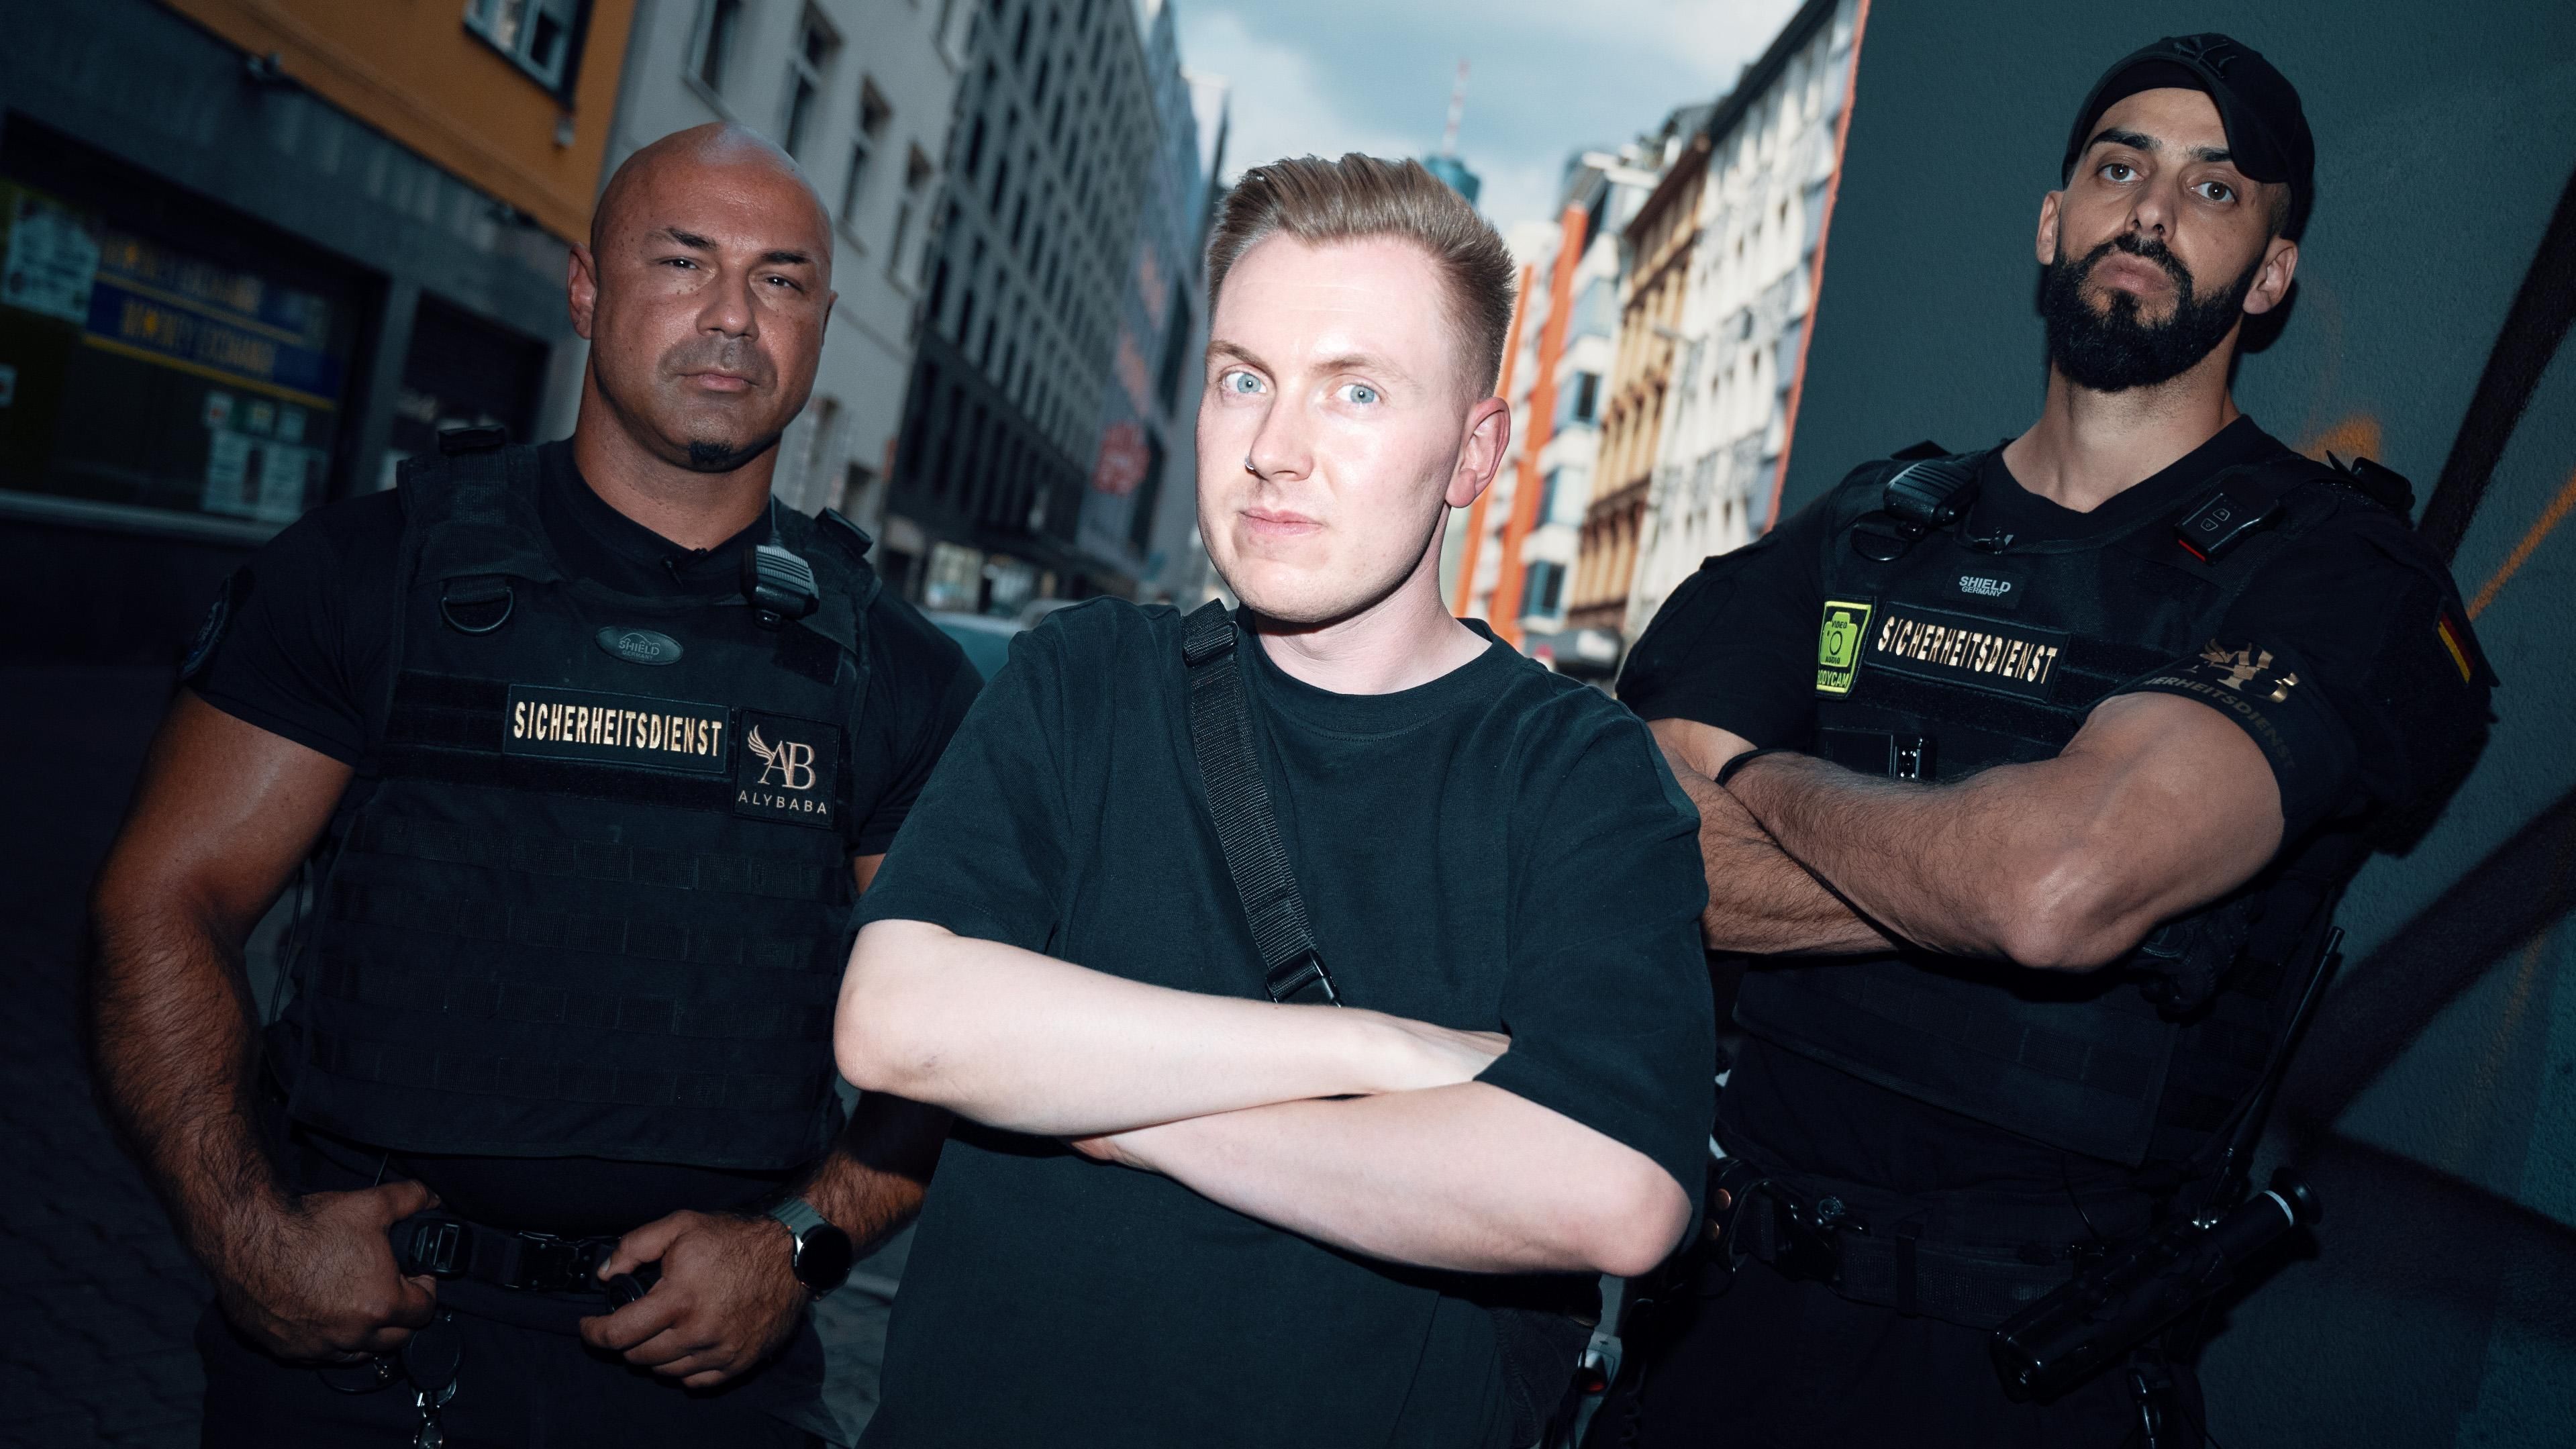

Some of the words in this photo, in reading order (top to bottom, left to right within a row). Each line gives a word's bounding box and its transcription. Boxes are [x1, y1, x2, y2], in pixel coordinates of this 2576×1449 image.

[1959, 576, 2011, 593] SHIELD
[1962, 585, 2001, 597] GERMANY
[1832, 620, 1848, 629] VIDEO
[618, 639, 660, 656] SHIELD
[622, 650, 654, 661] GERMANY
[1877, 615, 2059, 685] SICHERHEITSDIENST
[1825, 656, 1840, 664] AUDIO
[513, 701, 723, 758] SICHERHEITSDIENST
[757, 739, 817, 791] AB
[738, 789, 828, 815] ALYBABA
